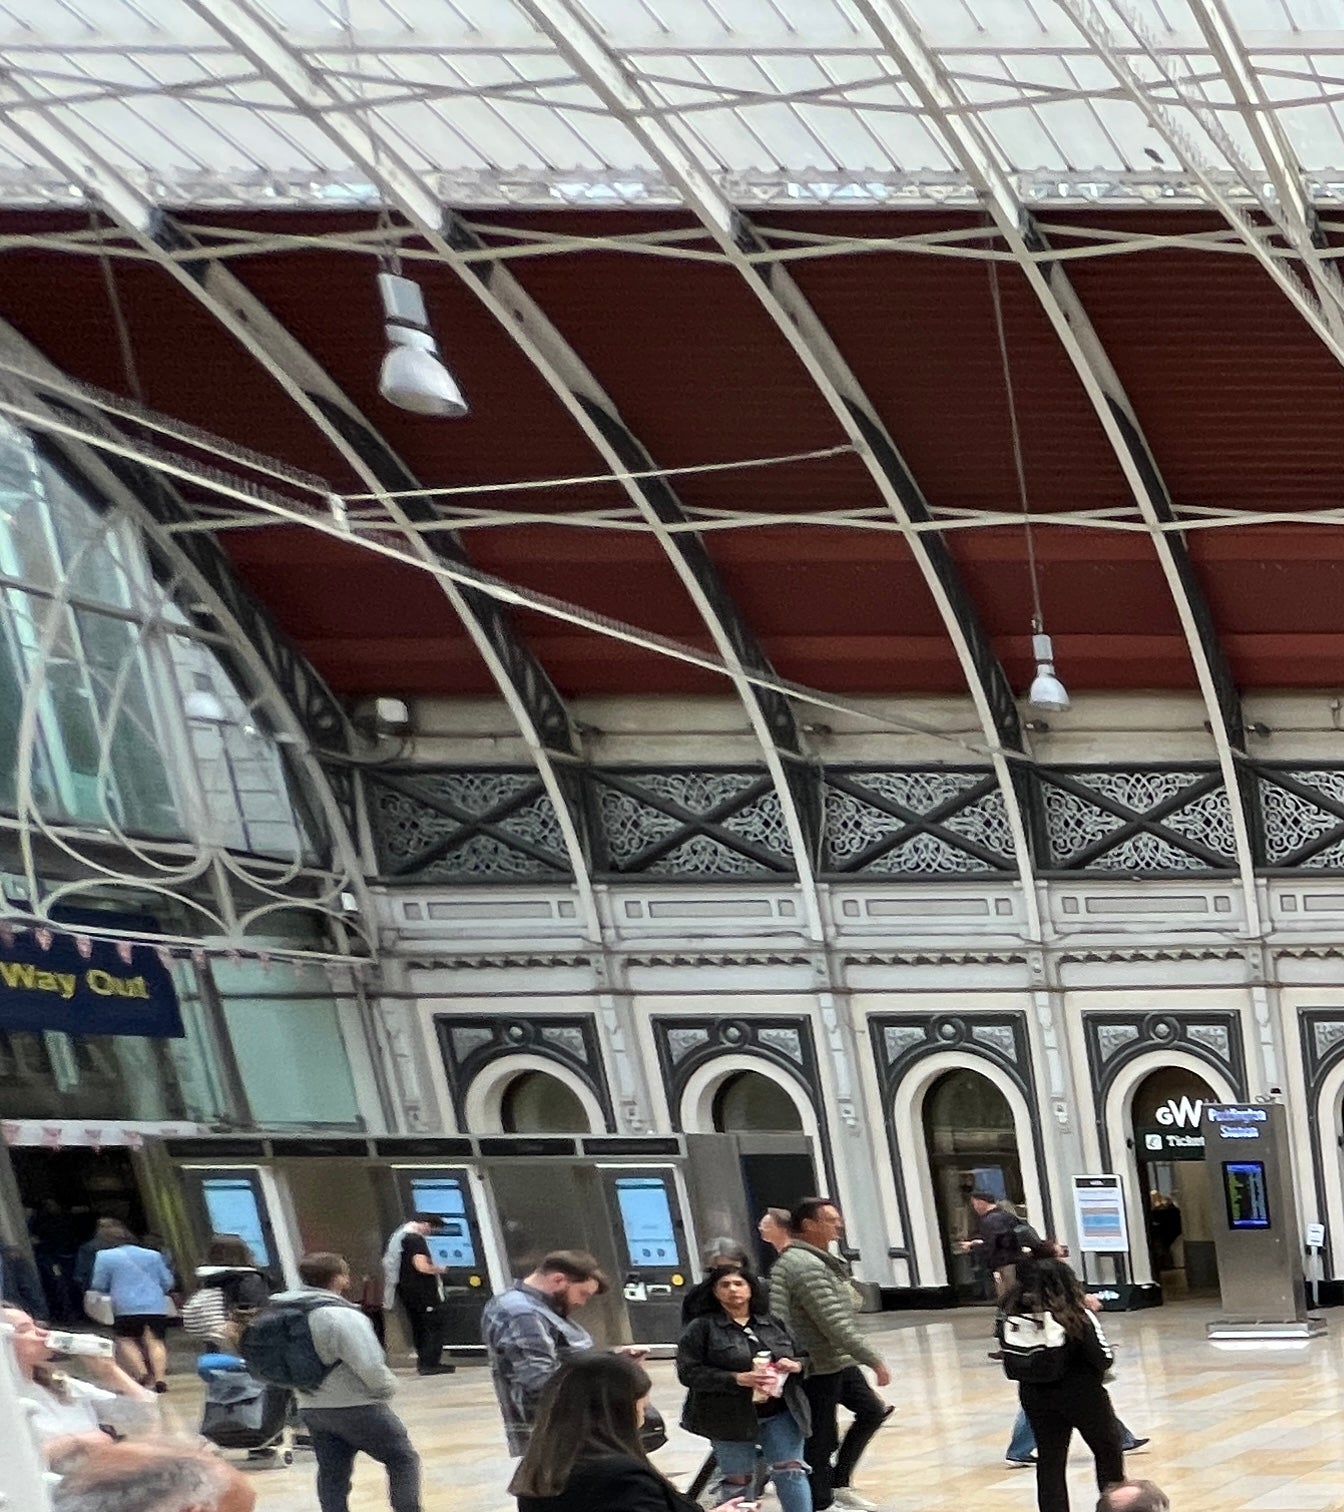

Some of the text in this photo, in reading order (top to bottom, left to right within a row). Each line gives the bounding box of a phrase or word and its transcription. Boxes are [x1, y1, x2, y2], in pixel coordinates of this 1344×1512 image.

[0, 961, 150, 999] Way Out
[1155, 1096, 1202, 1127] GW
